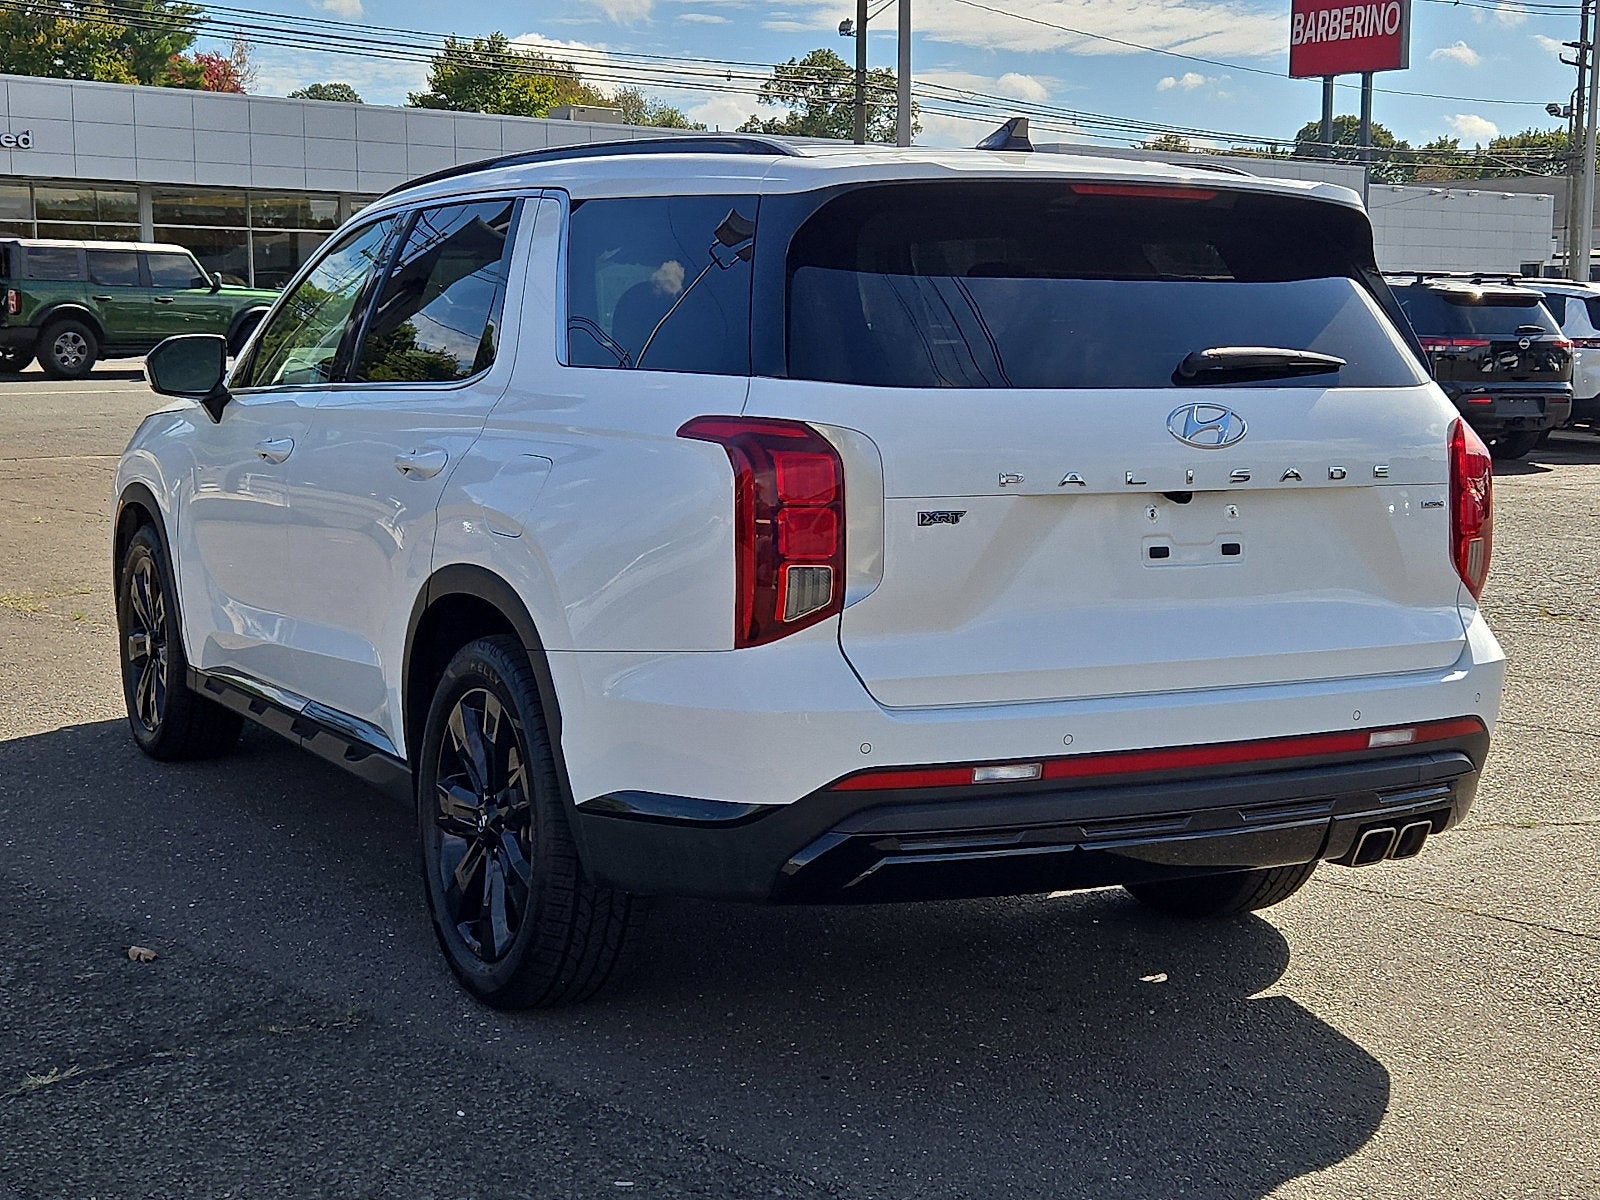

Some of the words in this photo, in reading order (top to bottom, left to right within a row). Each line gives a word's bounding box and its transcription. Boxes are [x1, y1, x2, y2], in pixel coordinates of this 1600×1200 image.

[1292, 1, 1400, 45] BARBERINO
[998, 463, 1390, 488] PALISADE
[917, 510, 967, 526] XRT
[470, 662, 501, 685] KELLY
